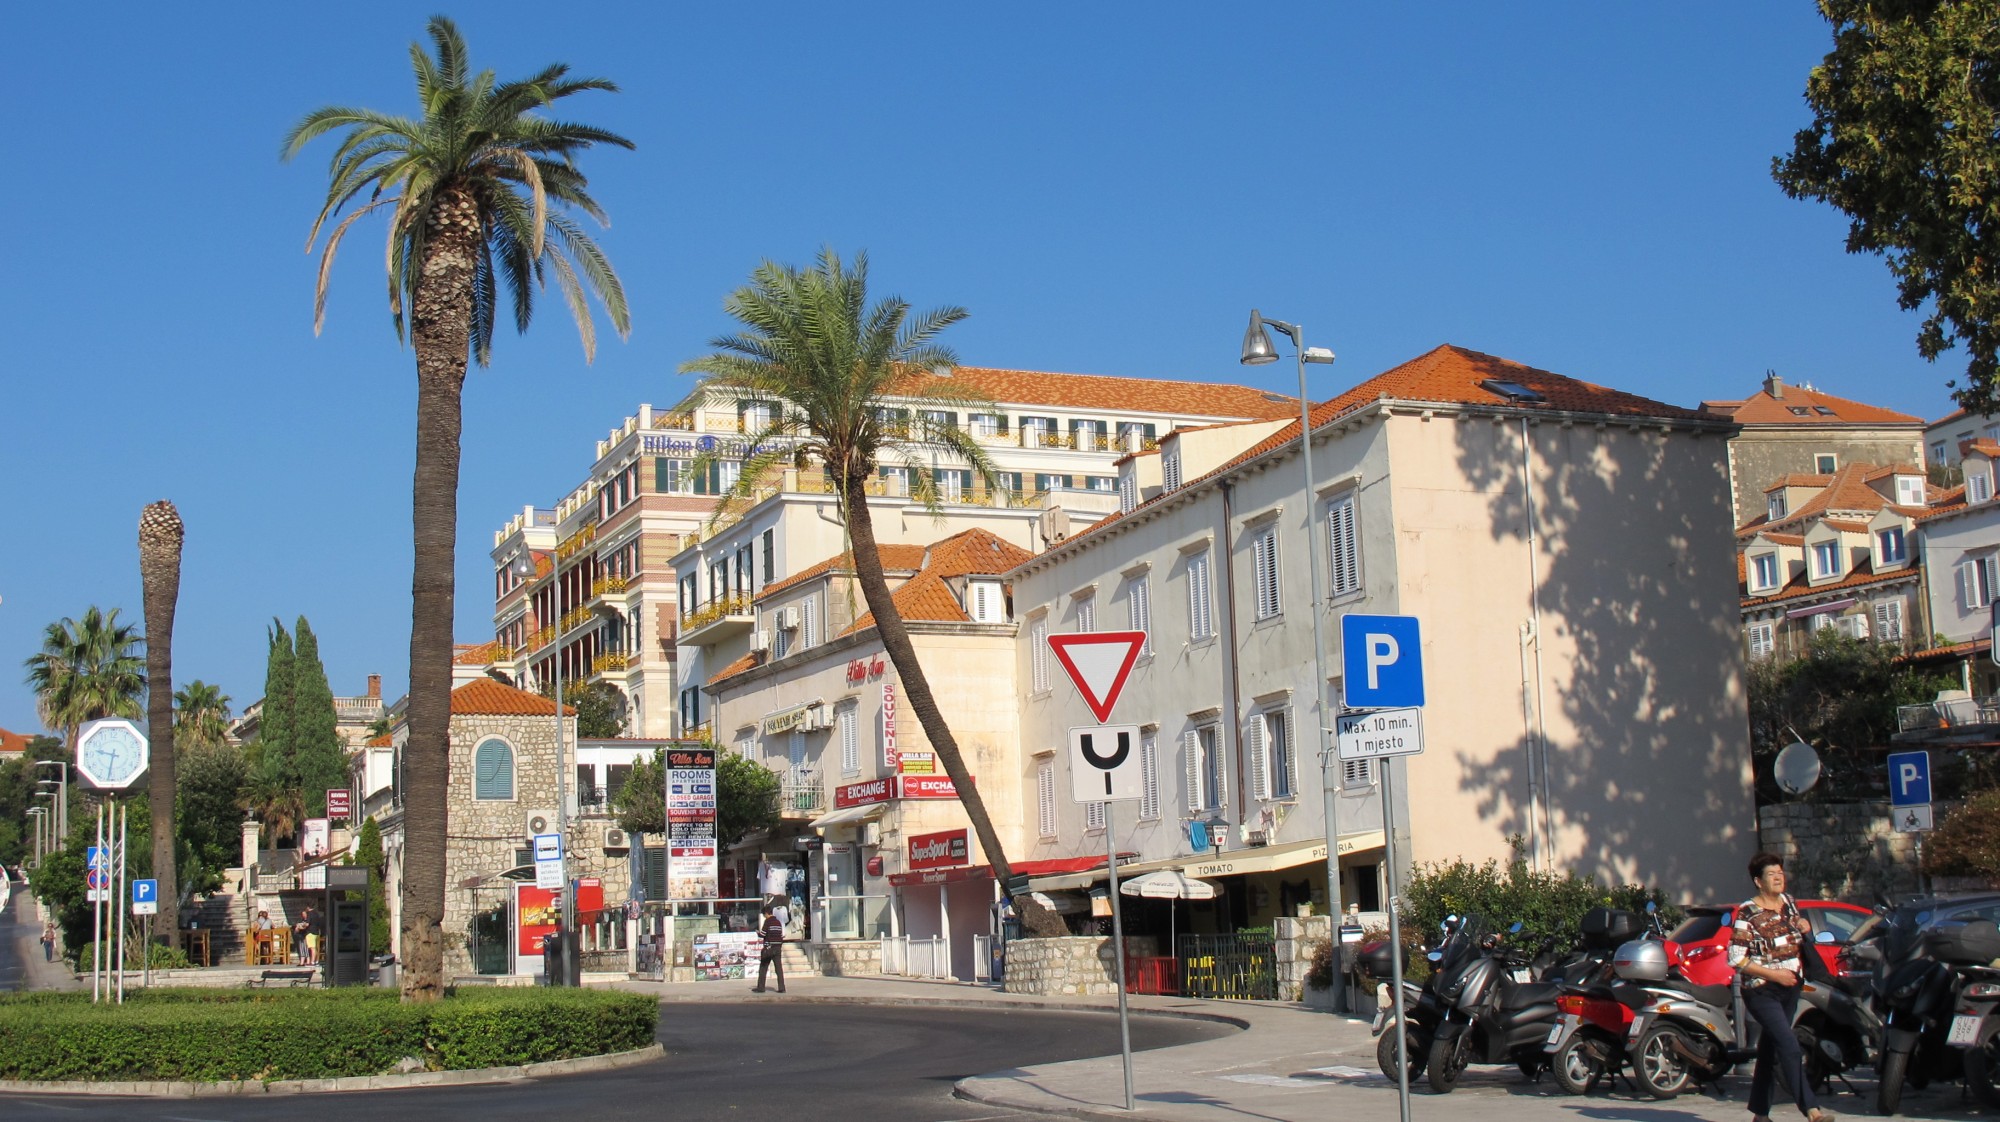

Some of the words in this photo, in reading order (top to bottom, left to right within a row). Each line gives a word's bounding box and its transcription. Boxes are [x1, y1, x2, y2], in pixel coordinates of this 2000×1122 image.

[644, 435, 693, 451] Hilton
[1365, 633, 1399, 689] P
[883, 684, 897, 765] SOUVENIRS
[1344, 721, 1371, 735] Max.
[1374, 717, 1385, 731] 10
[1388, 716, 1412, 730] min.
[1356, 739, 1360, 752] 1
[1364, 735, 1404, 753] mjesto
[669, 752, 693, 765] Villa
[694, 752, 713, 764] San
[672, 770, 711, 779] ROOMS
[1900, 763, 1917, 795] P
[847, 781, 886, 800] EXCHANGE
[920, 781, 957, 790] EXCHA
[911, 838, 950, 862] SuperSport
[1312, 842, 1354, 858] PIZRIA
[1198, 863, 1233, 875] TOMATO
[139, 883, 150, 899] P
